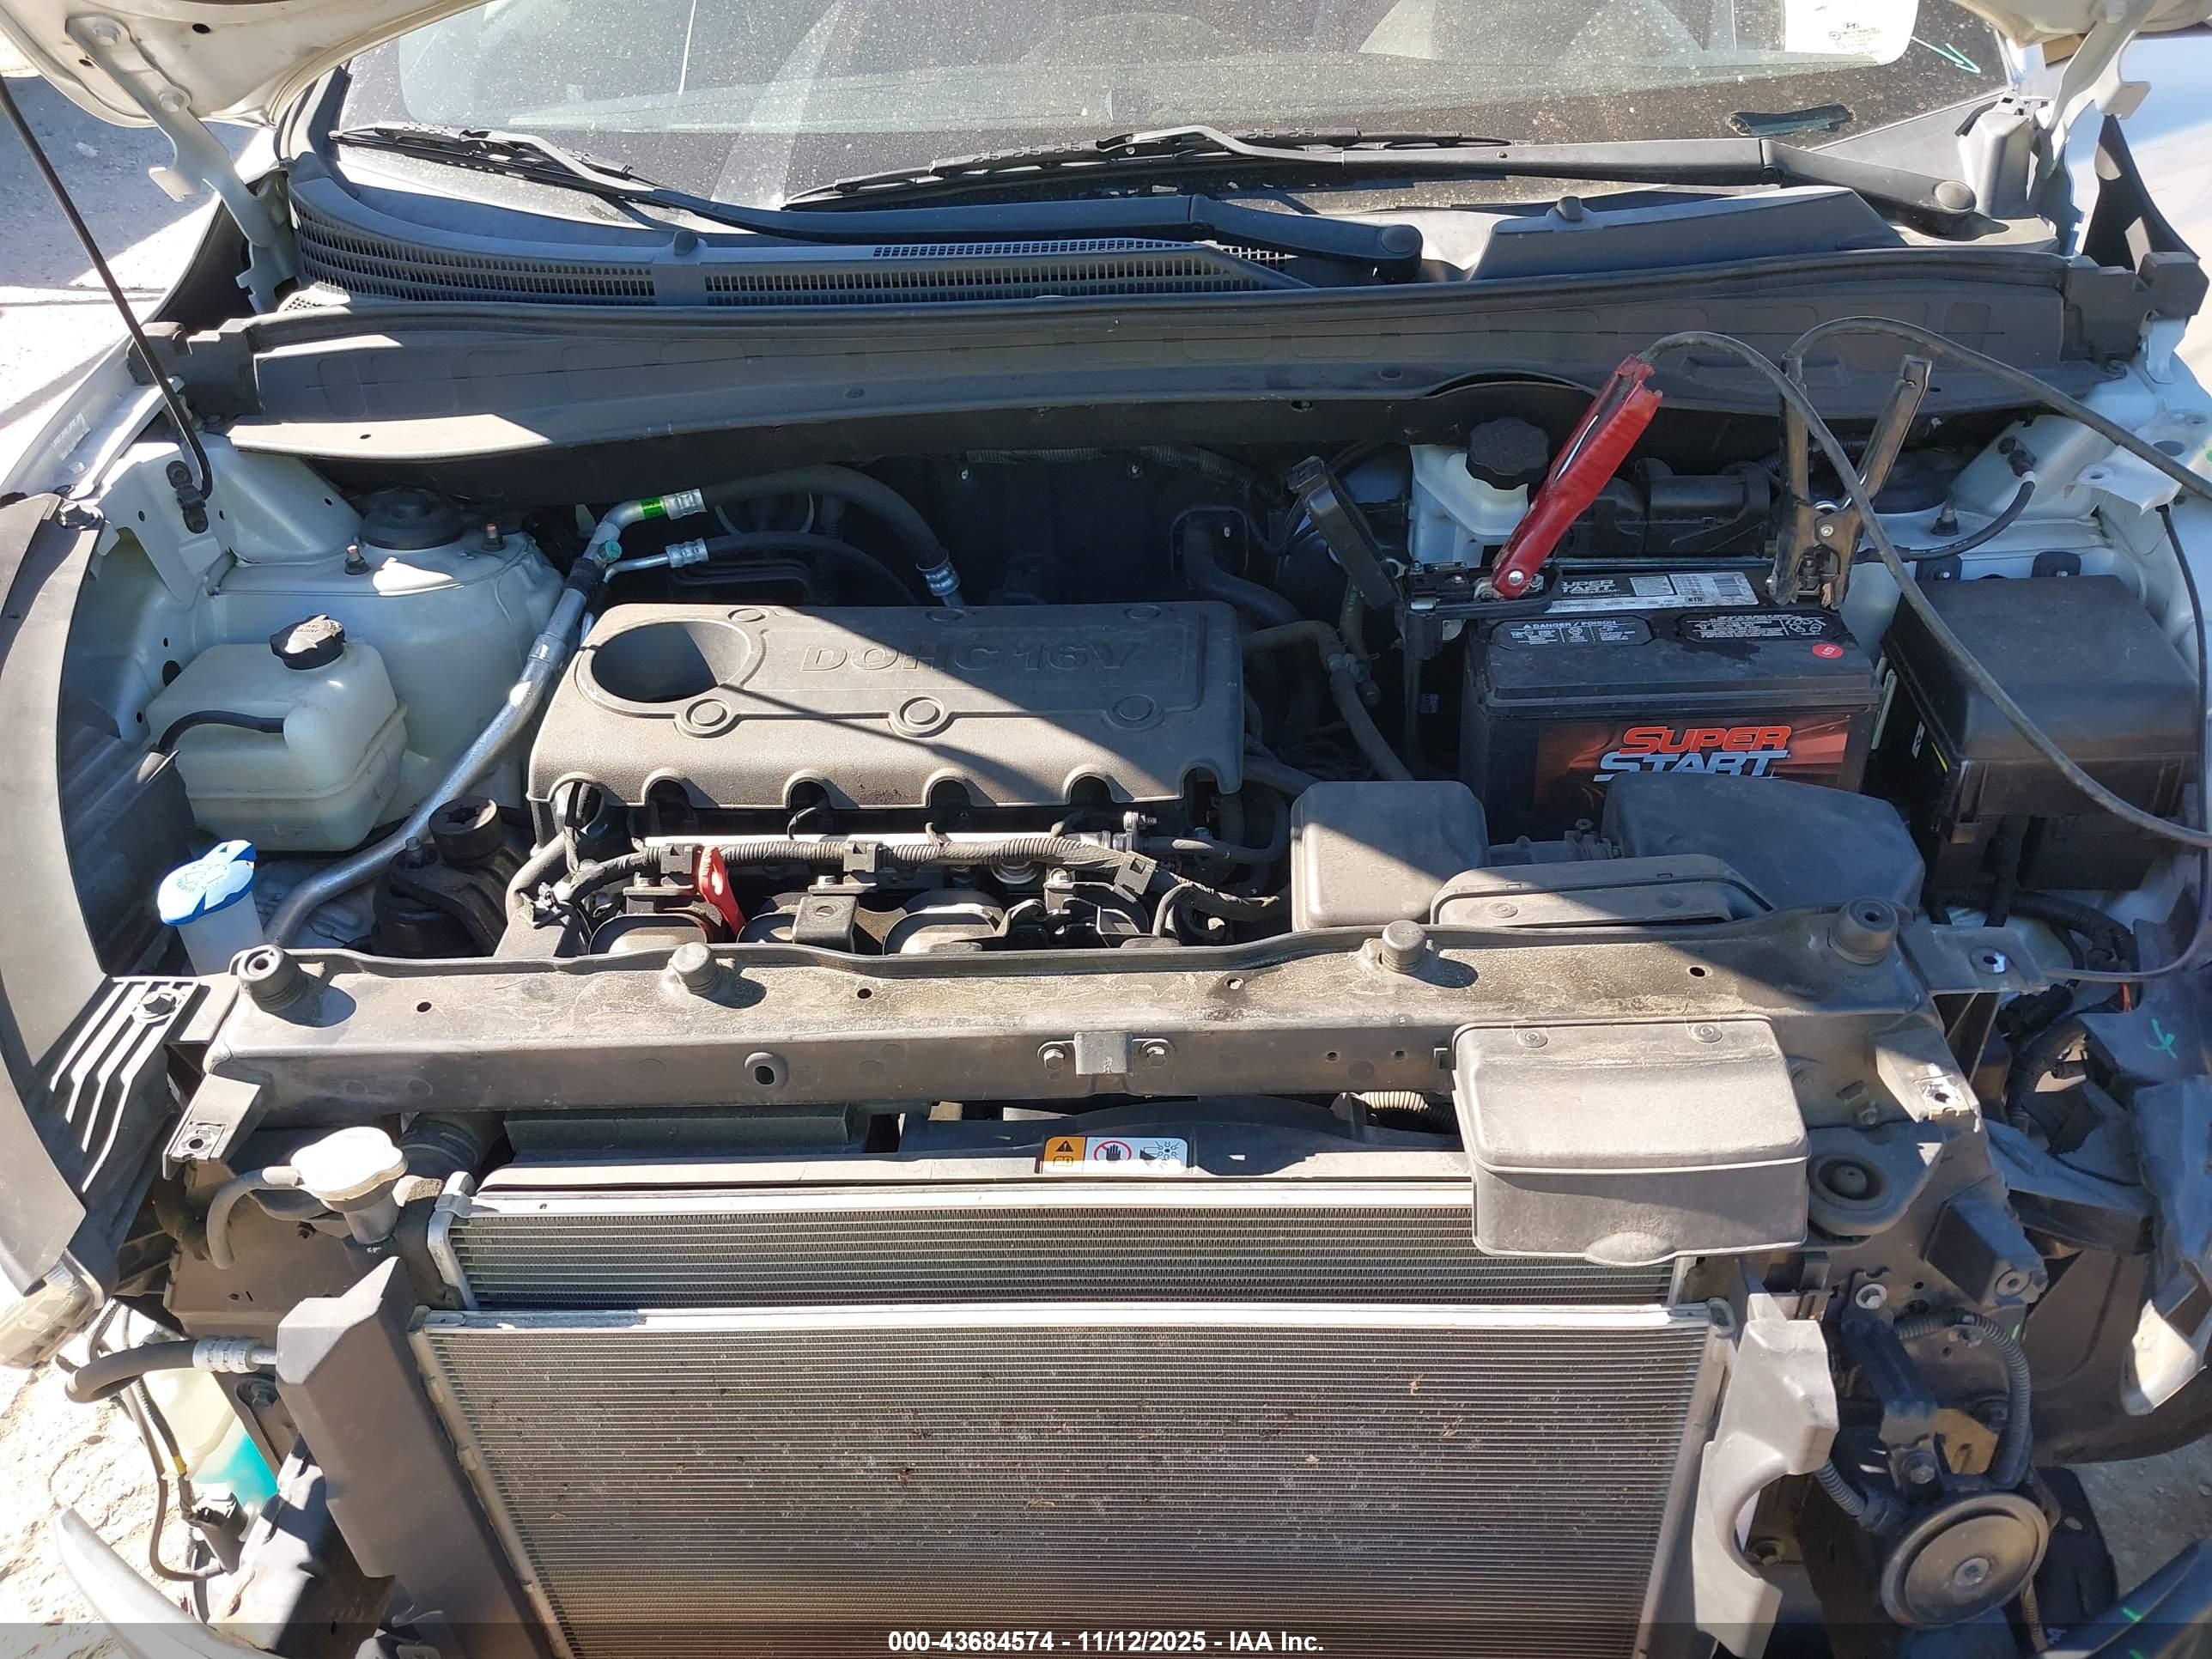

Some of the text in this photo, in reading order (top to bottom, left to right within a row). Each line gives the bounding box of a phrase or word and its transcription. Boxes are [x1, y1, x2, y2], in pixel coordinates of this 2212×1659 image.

[799, 641, 1141, 672] DOHC 16V
[1619, 726, 1792, 755] SUPER
[1593, 750, 1790, 782] START
